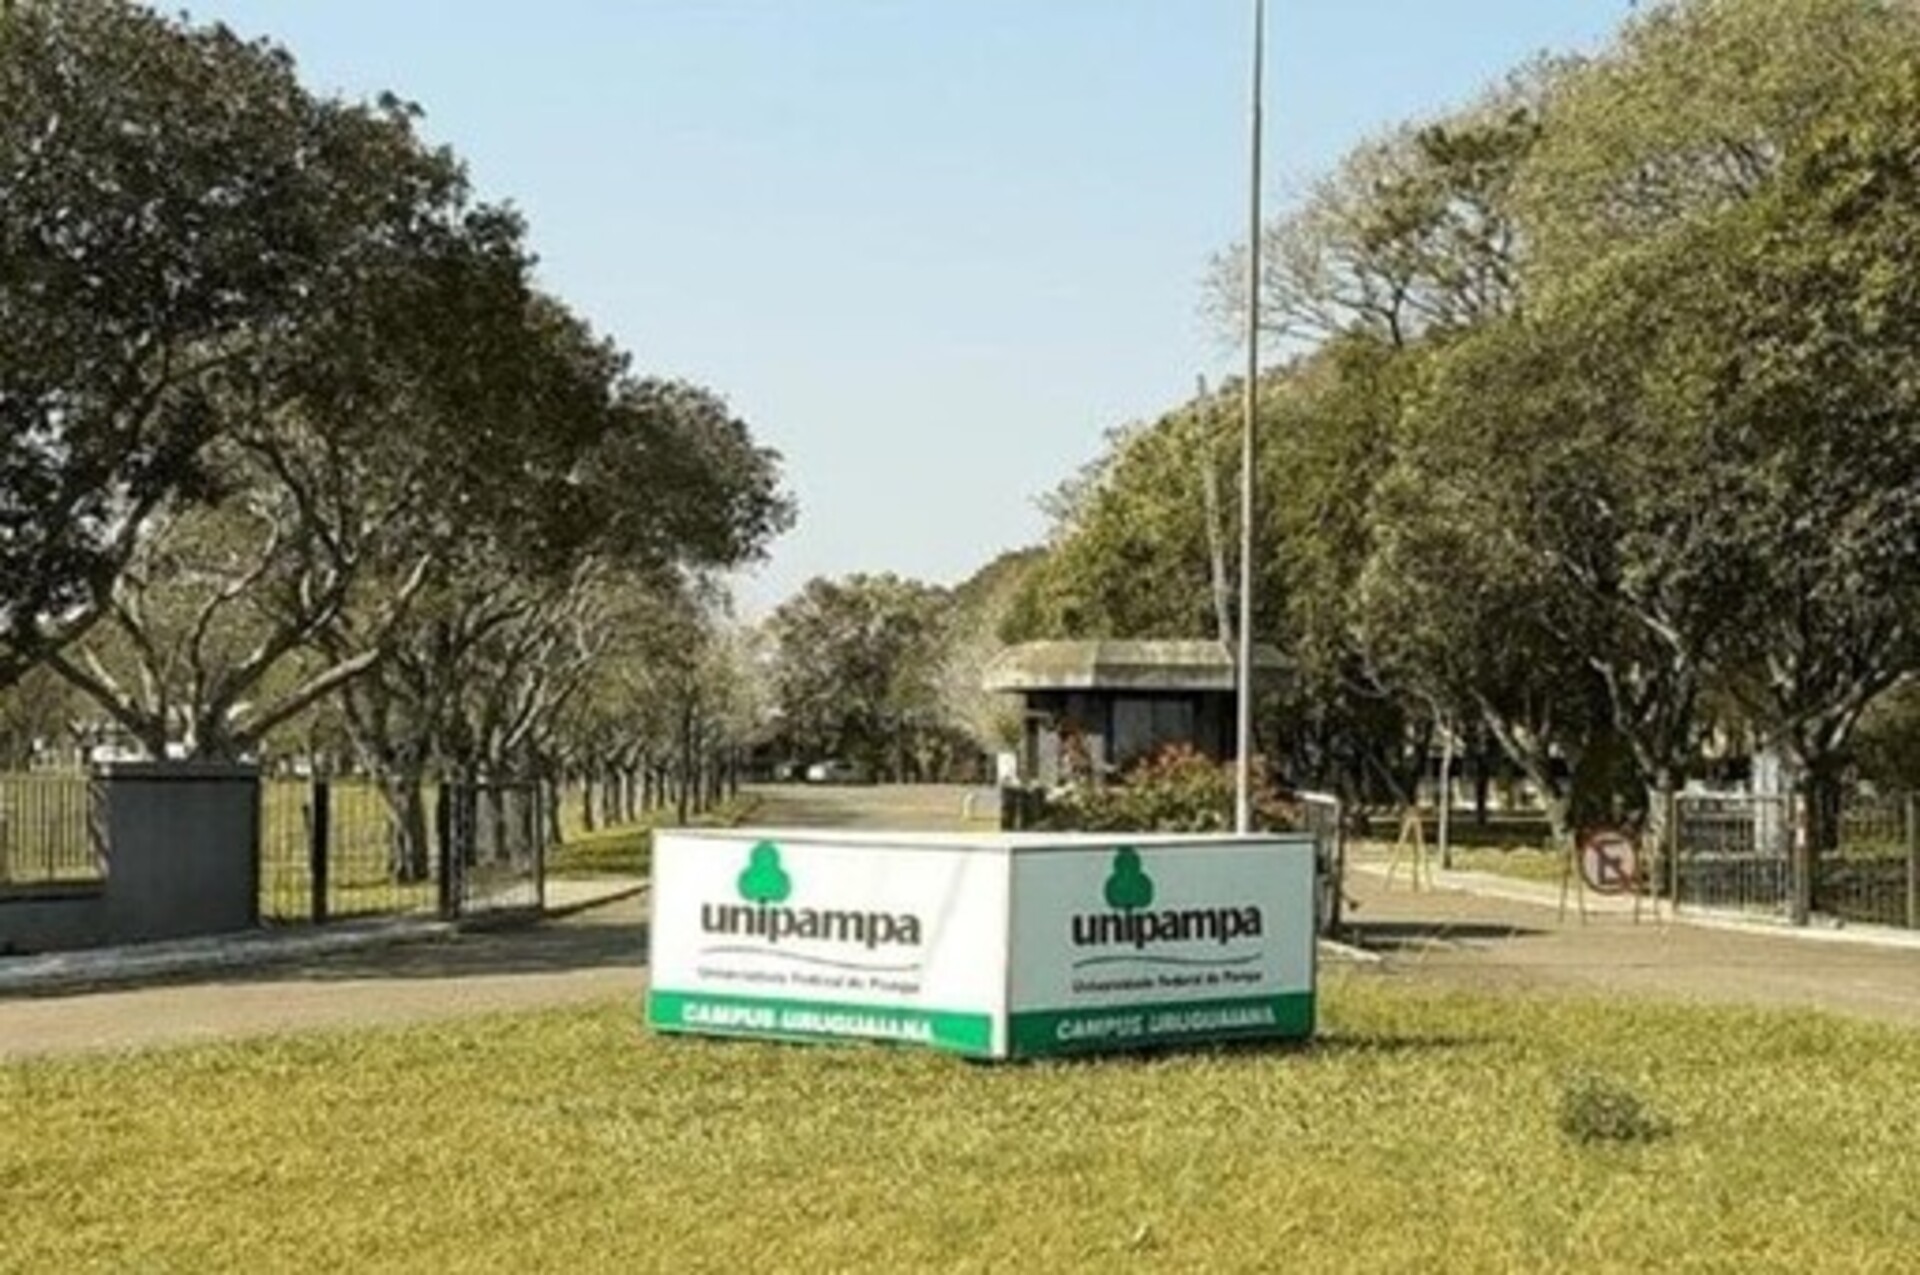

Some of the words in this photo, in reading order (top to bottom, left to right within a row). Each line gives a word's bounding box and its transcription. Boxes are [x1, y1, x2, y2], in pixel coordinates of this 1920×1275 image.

[701, 900, 921, 949] unipampa
[1072, 906, 1262, 949] unipampa
[681, 1001, 775, 1028] CAMPUS
[1056, 1014, 1142, 1040] CAMPUS
